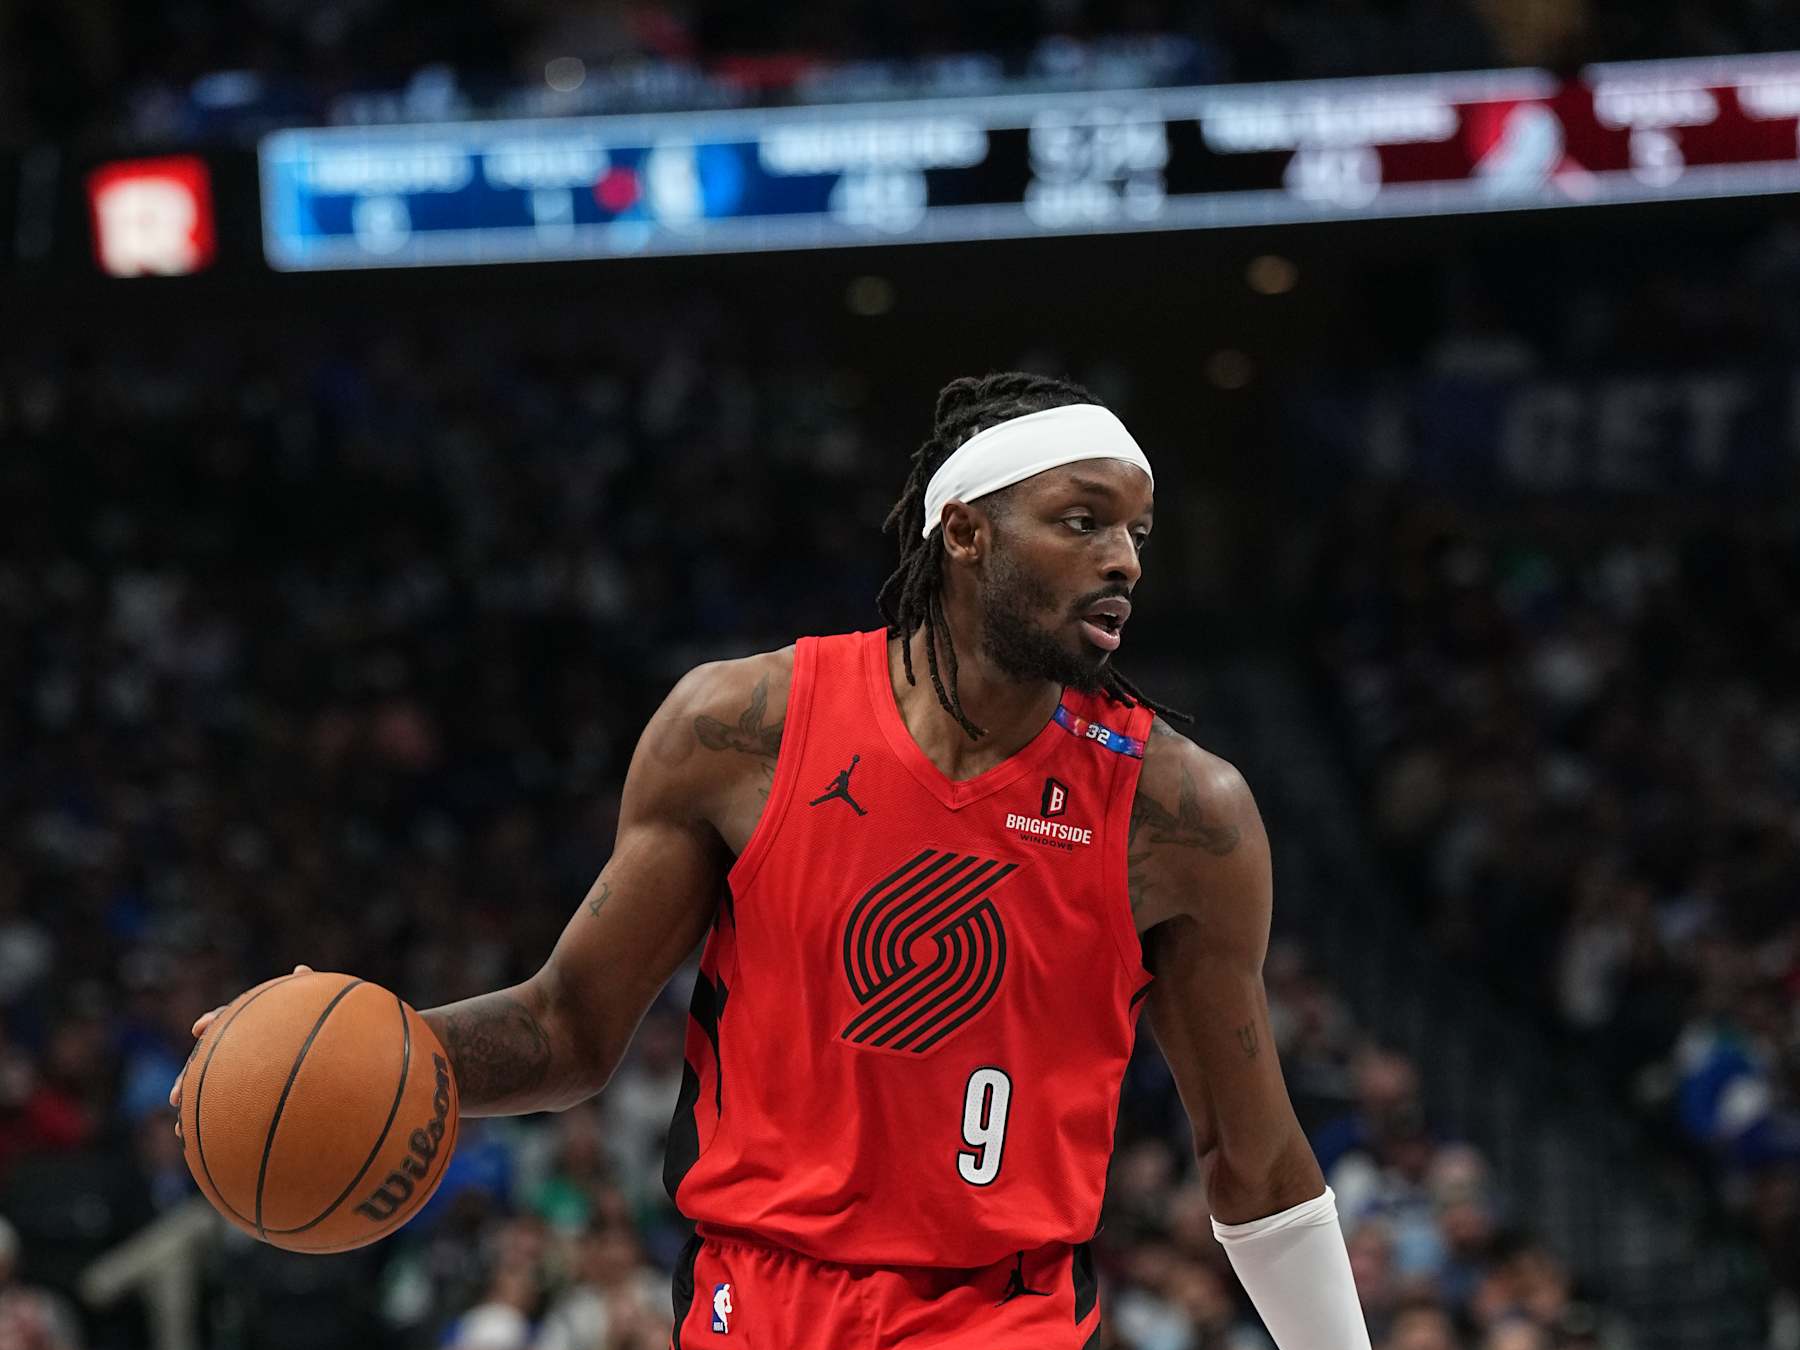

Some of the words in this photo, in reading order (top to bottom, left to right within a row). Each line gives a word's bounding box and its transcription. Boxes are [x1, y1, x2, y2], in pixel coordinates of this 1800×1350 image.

[1085, 724, 1111, 744] 32
[1050, 786, 1064, 812] B
[1006, 813, 1092, 844] BRIGHTSIDE
[1020, 834, 1073, 850] WINDOWS
[956, 1065, 1013, 1187] 9
